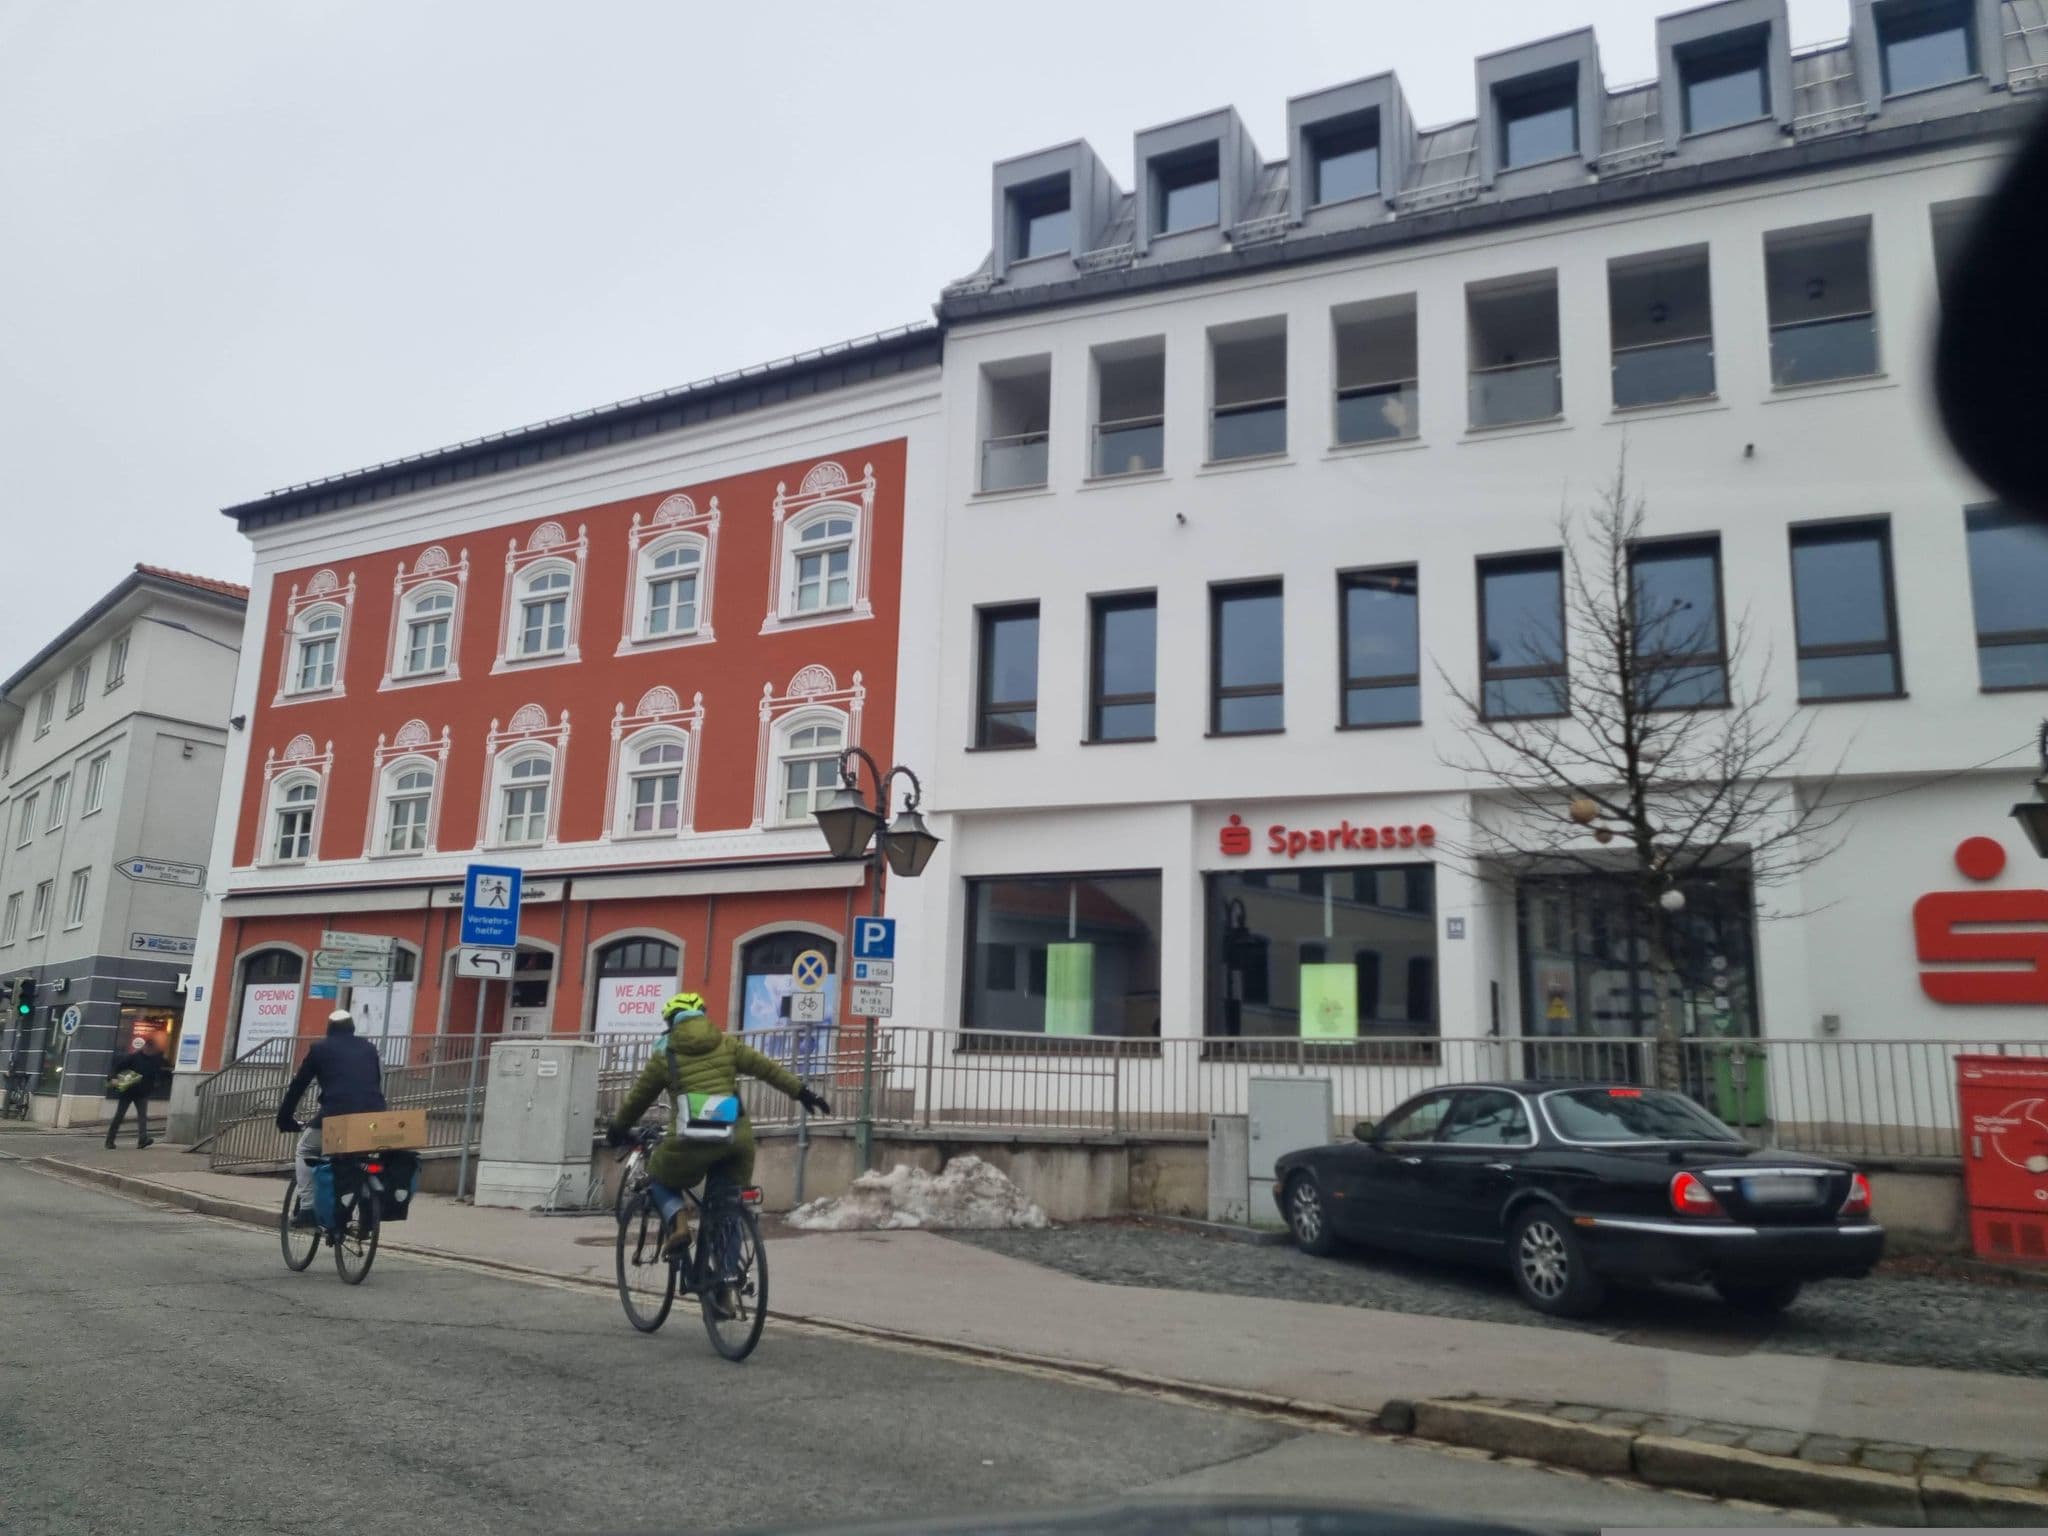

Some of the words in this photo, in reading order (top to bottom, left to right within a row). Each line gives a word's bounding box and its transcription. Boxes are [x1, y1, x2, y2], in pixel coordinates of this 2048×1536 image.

[1268, 820, 1436, 858] Sparkasse
[467, 913, 512, 925] Verkehrs-
[475, 926, 503, 936] helfer
[863, 922, 887, 954] P
[254, 989, 295, 1001] OPENING
[616, 985, 634, 997] WE
[637, 985, 662, 997] ARE
[258, 1004, 288, 1016] SOON!
[618, 1002, 655, 1014] OPEN!
[531, 1048, 540, 1059] 23
